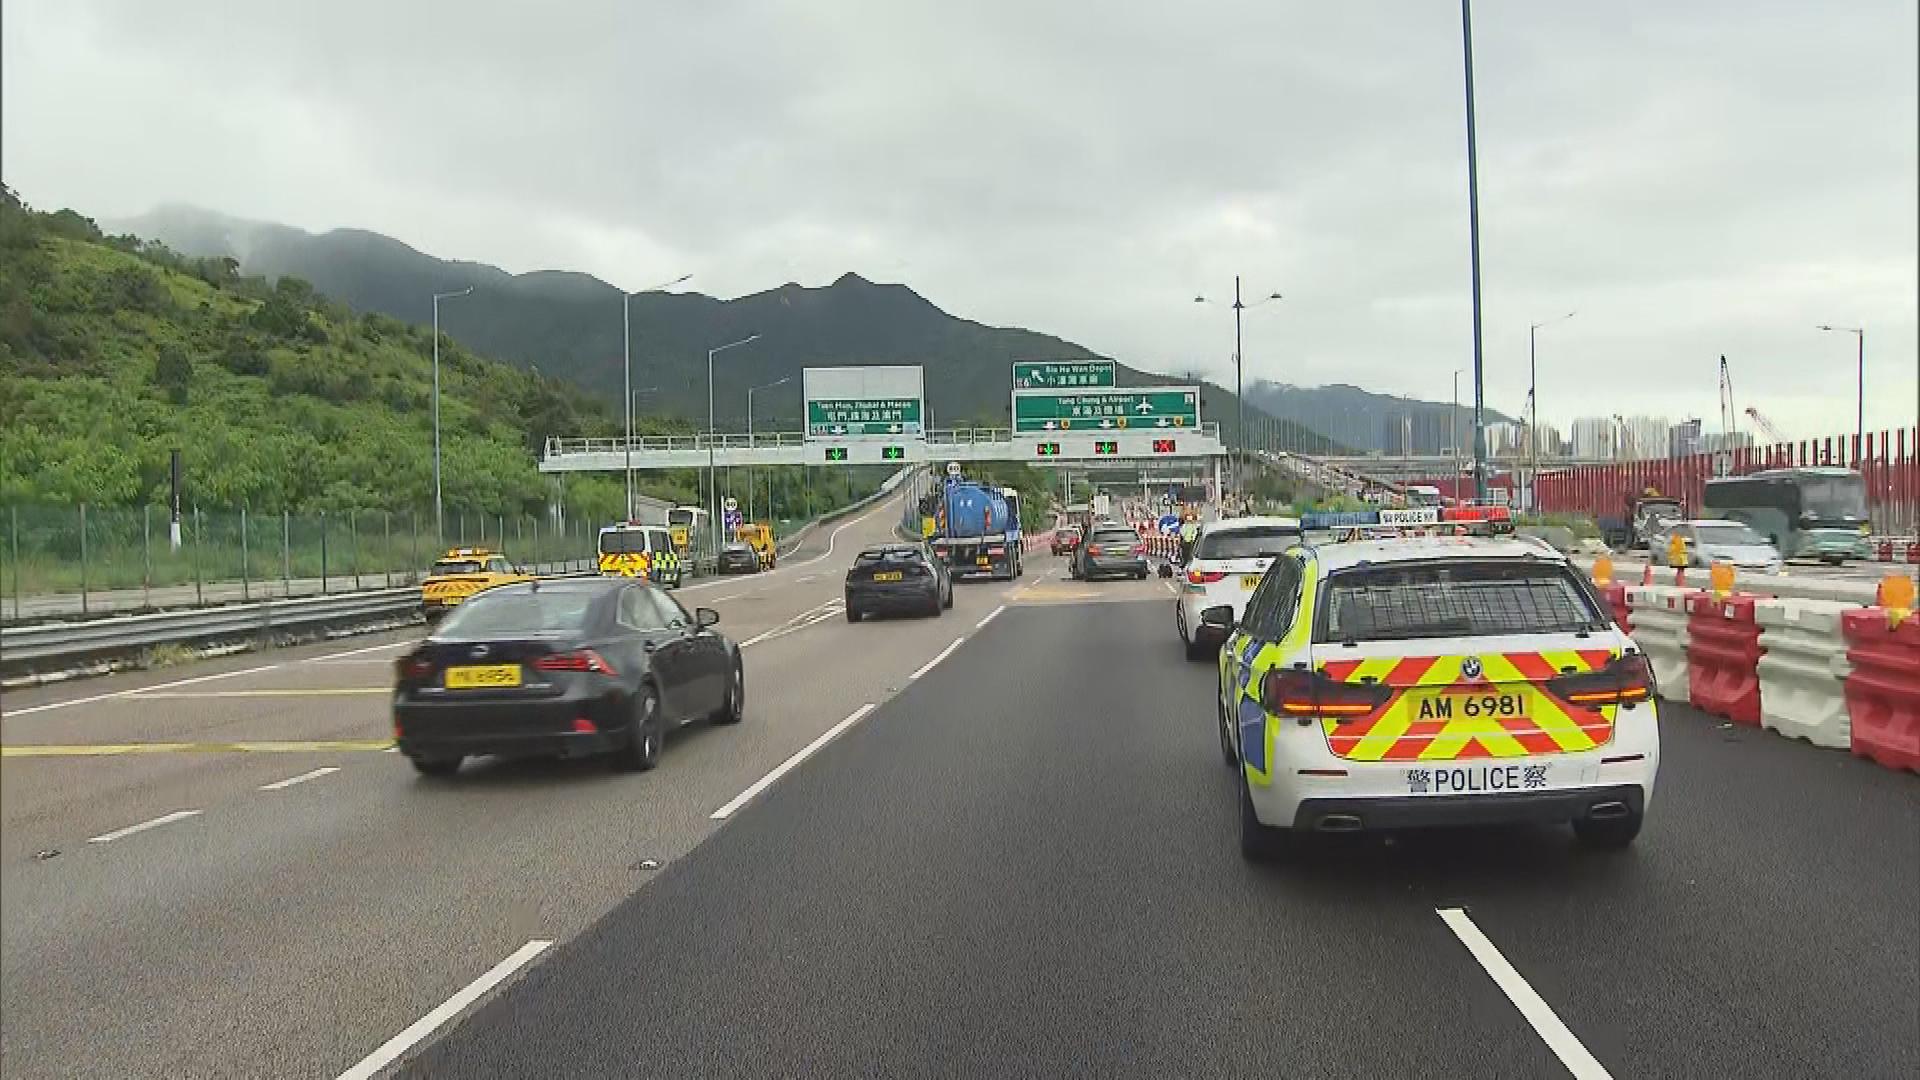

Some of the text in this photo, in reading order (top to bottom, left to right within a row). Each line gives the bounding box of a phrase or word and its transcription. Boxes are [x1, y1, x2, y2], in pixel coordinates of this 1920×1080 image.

[1108, 395, 1134, 404] Airport
[1419, 694, 1524, 718] AM 6981
